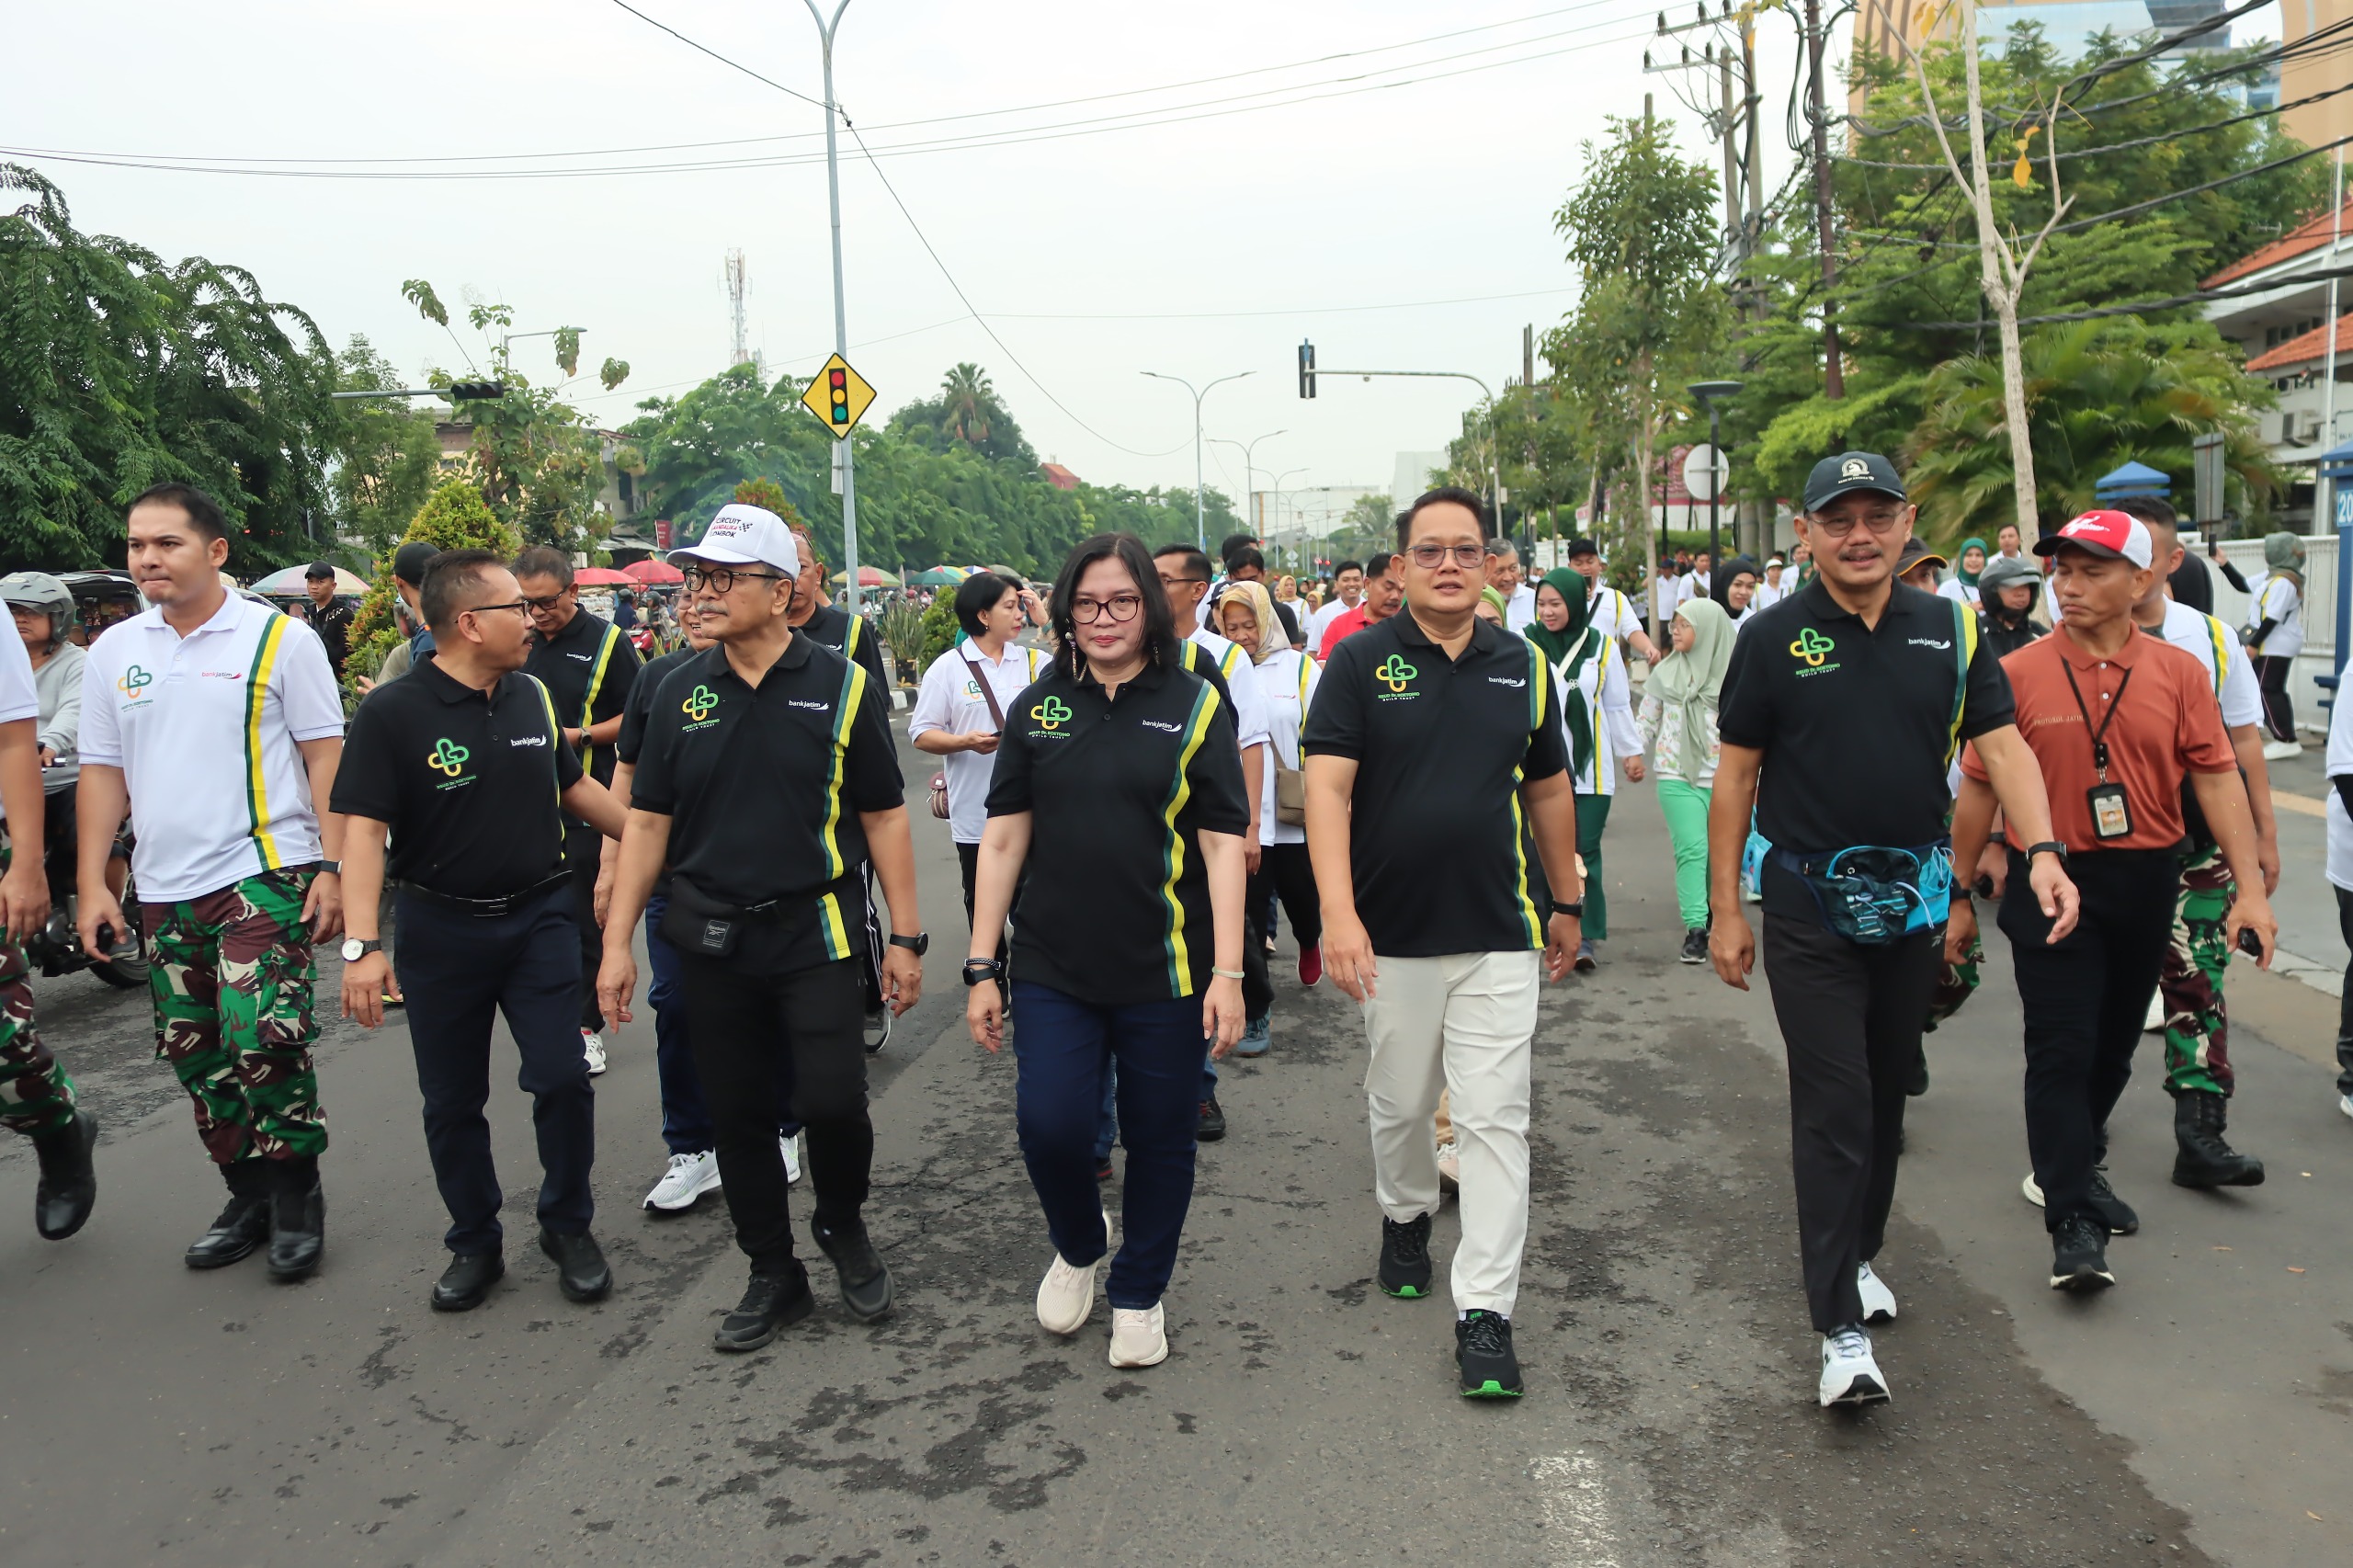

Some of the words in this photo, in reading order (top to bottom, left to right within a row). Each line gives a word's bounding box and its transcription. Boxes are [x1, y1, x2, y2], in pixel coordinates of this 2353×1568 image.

[716, 517, 742, 525] CIRCUIT
[1908, 638, 1941, 647] bankjatim
[1488, 676, 1518, 685] bankjatim
[789, 699, 821, 709] bankjatim
[1142, 719, 1173, 730] bankjatim
[511, 735, 541, 746] bankjatim
